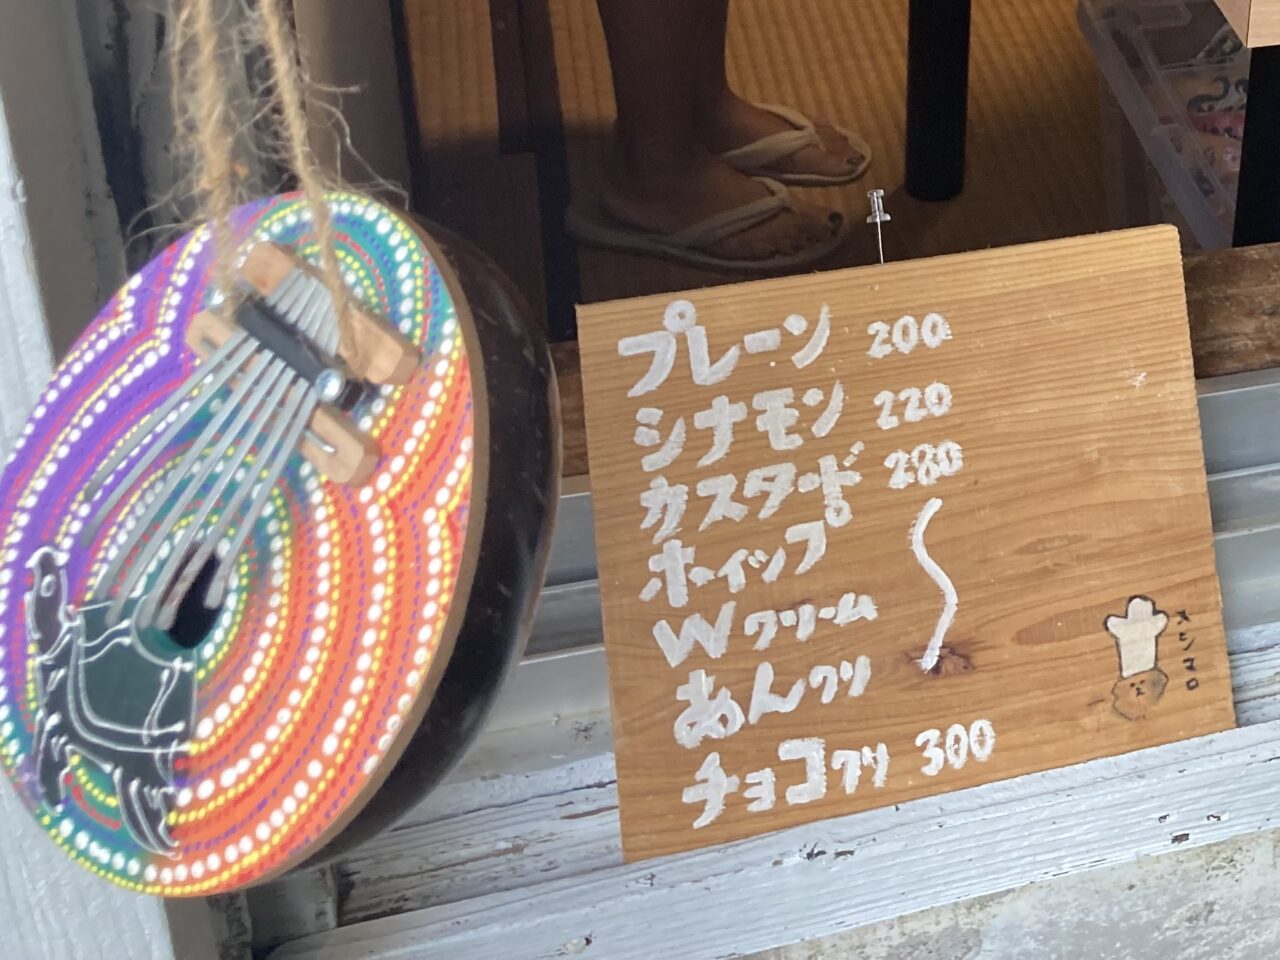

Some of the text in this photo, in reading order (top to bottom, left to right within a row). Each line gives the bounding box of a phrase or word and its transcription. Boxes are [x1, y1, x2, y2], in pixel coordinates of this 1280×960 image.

[617, 299, 953, 398] プレーン 200
[634, 380, 953, 472] シナモン 220
[640, 440, 964, 545] カスタード 280
[639, 500, 853, 608] ホイップ
[915, 719, 996, 777] 300
